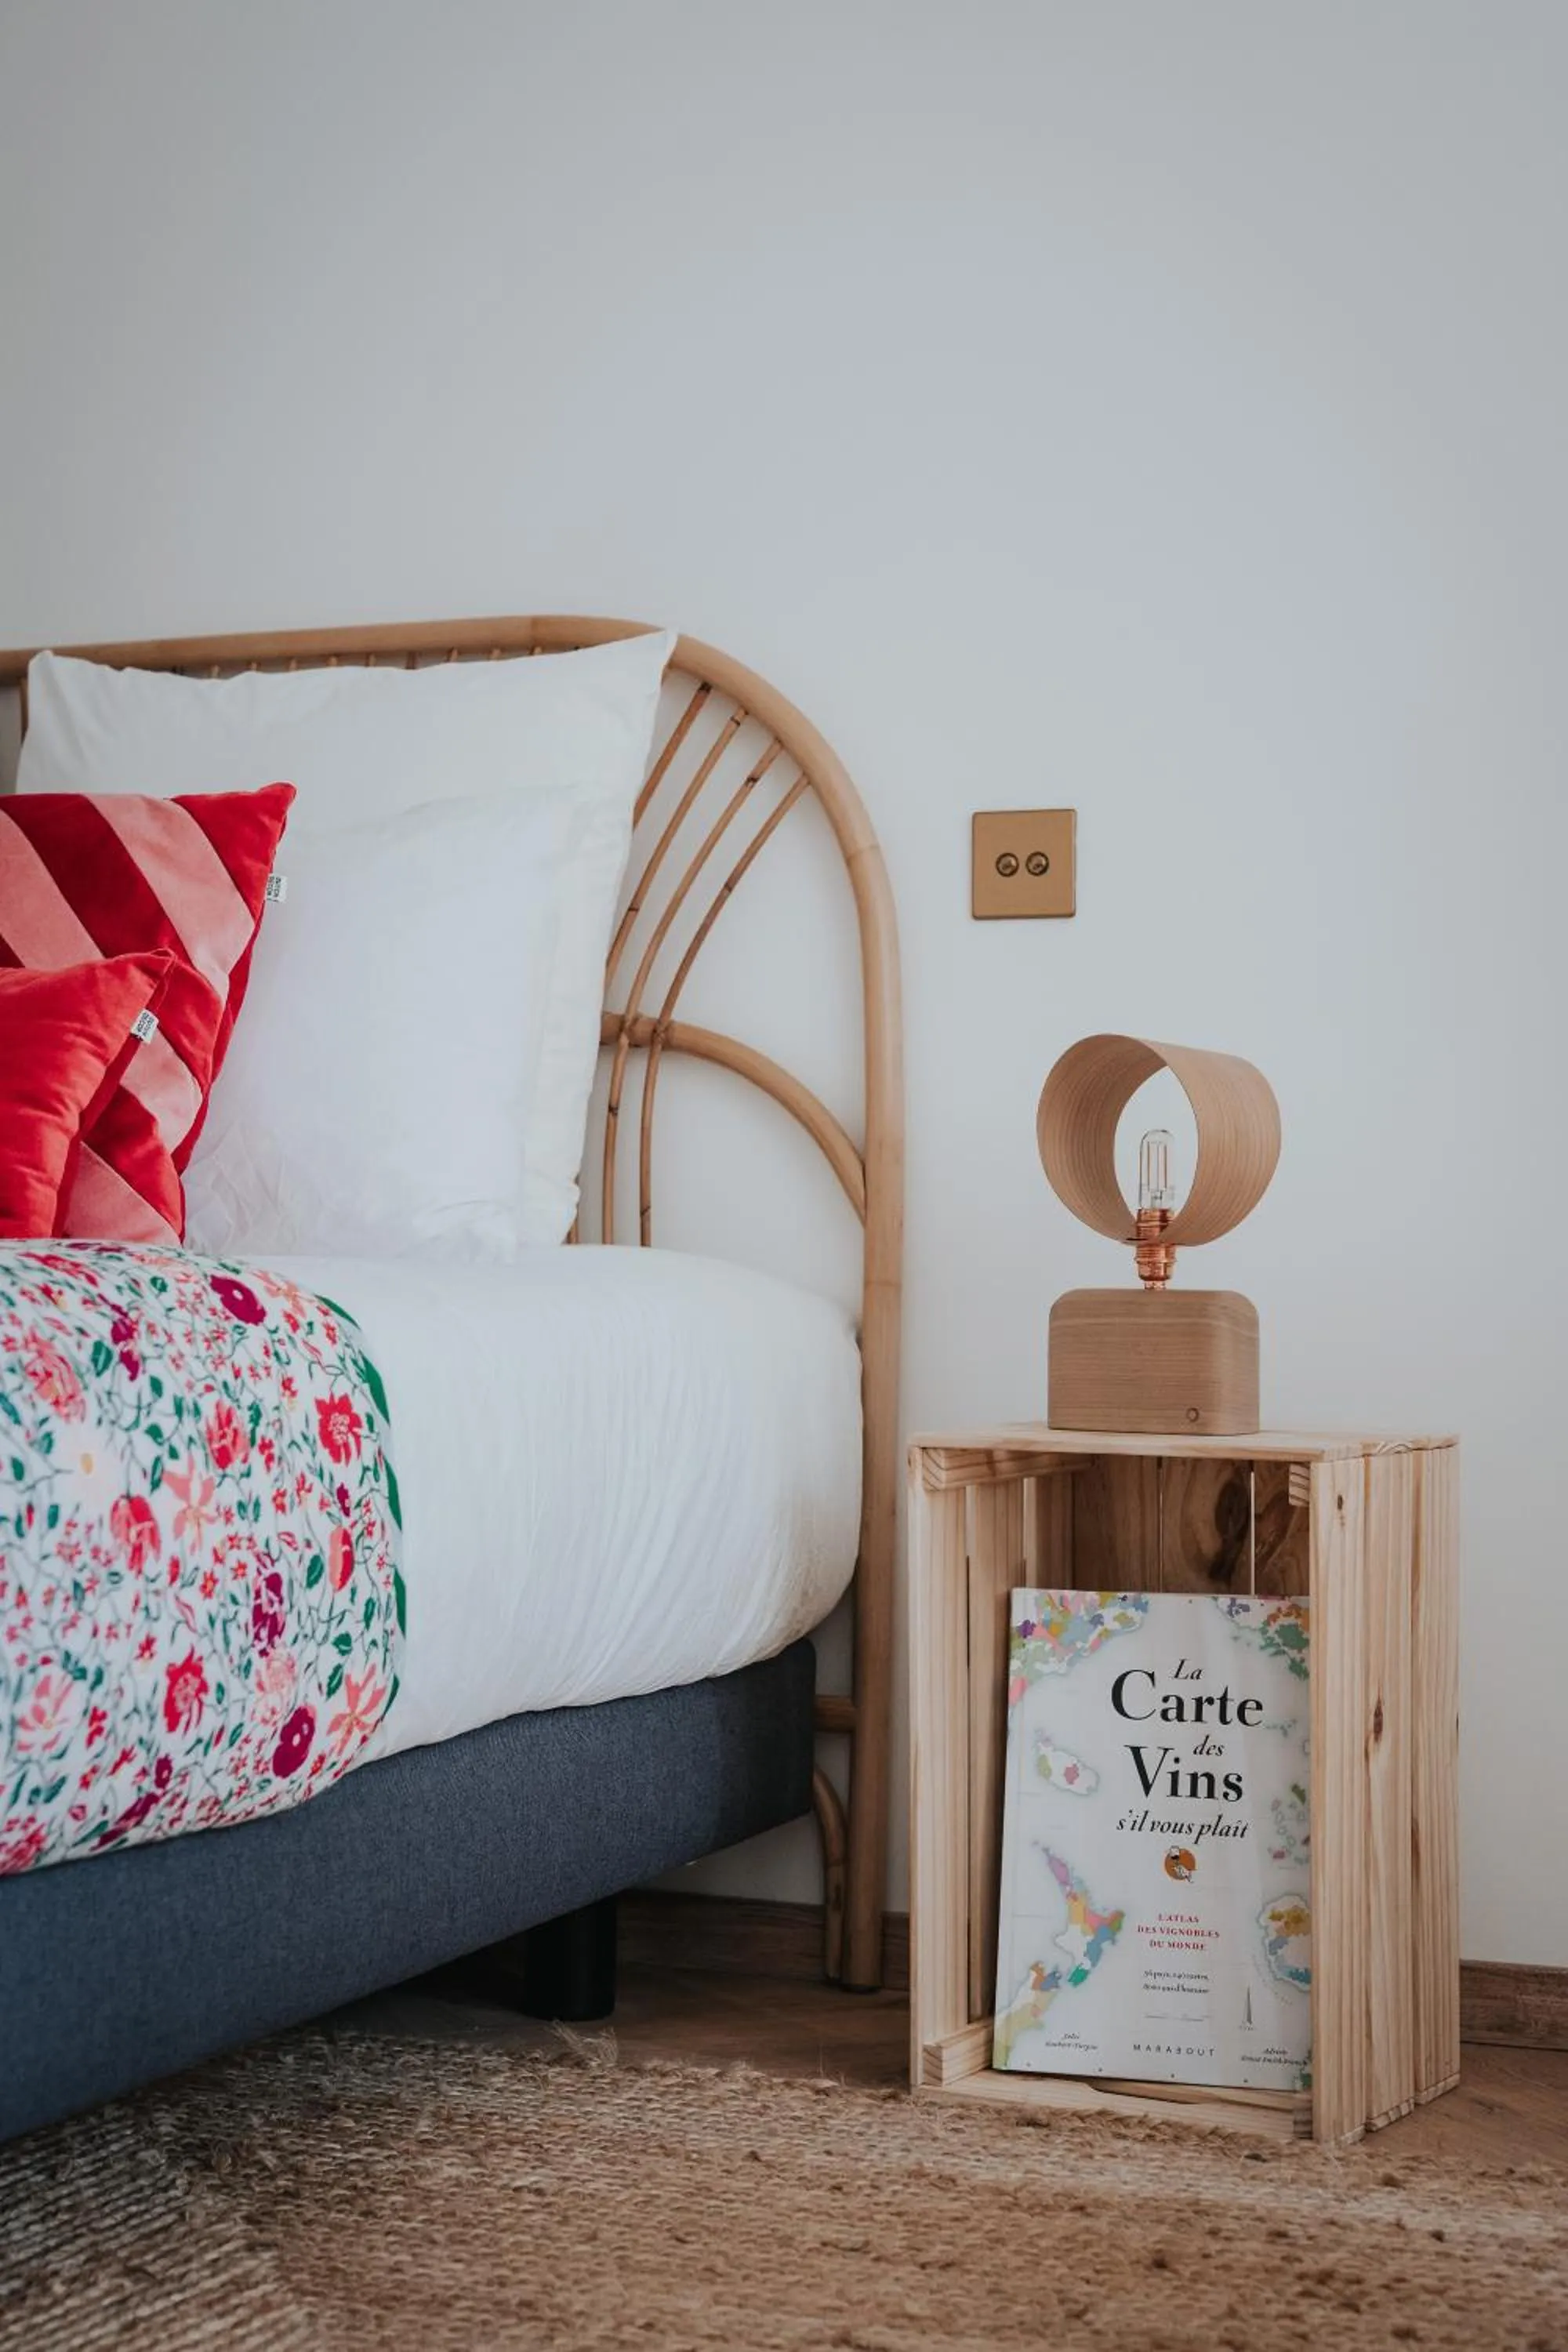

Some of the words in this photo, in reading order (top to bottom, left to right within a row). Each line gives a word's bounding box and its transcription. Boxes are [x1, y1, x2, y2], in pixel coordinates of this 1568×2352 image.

[1174, 1658, 1202, 1680] La
[1111, 1669, 1263, 1727] Carte
[1192, 1734, 1225, 1756] des
[1123, 1744, 1243, 1802] Vins
[1116, 1809, 1148, 1832] s'il
[1150, 1820, 1195, 1835] vous
[1193, 1813, 1249, 1844] plaît
[1160, 1926, 1220, 1938] VIGNOBLES
[1167, 1941, 1207, 1951] MONDE
[1133, 2044, 1215, 2056] MARABOUT
